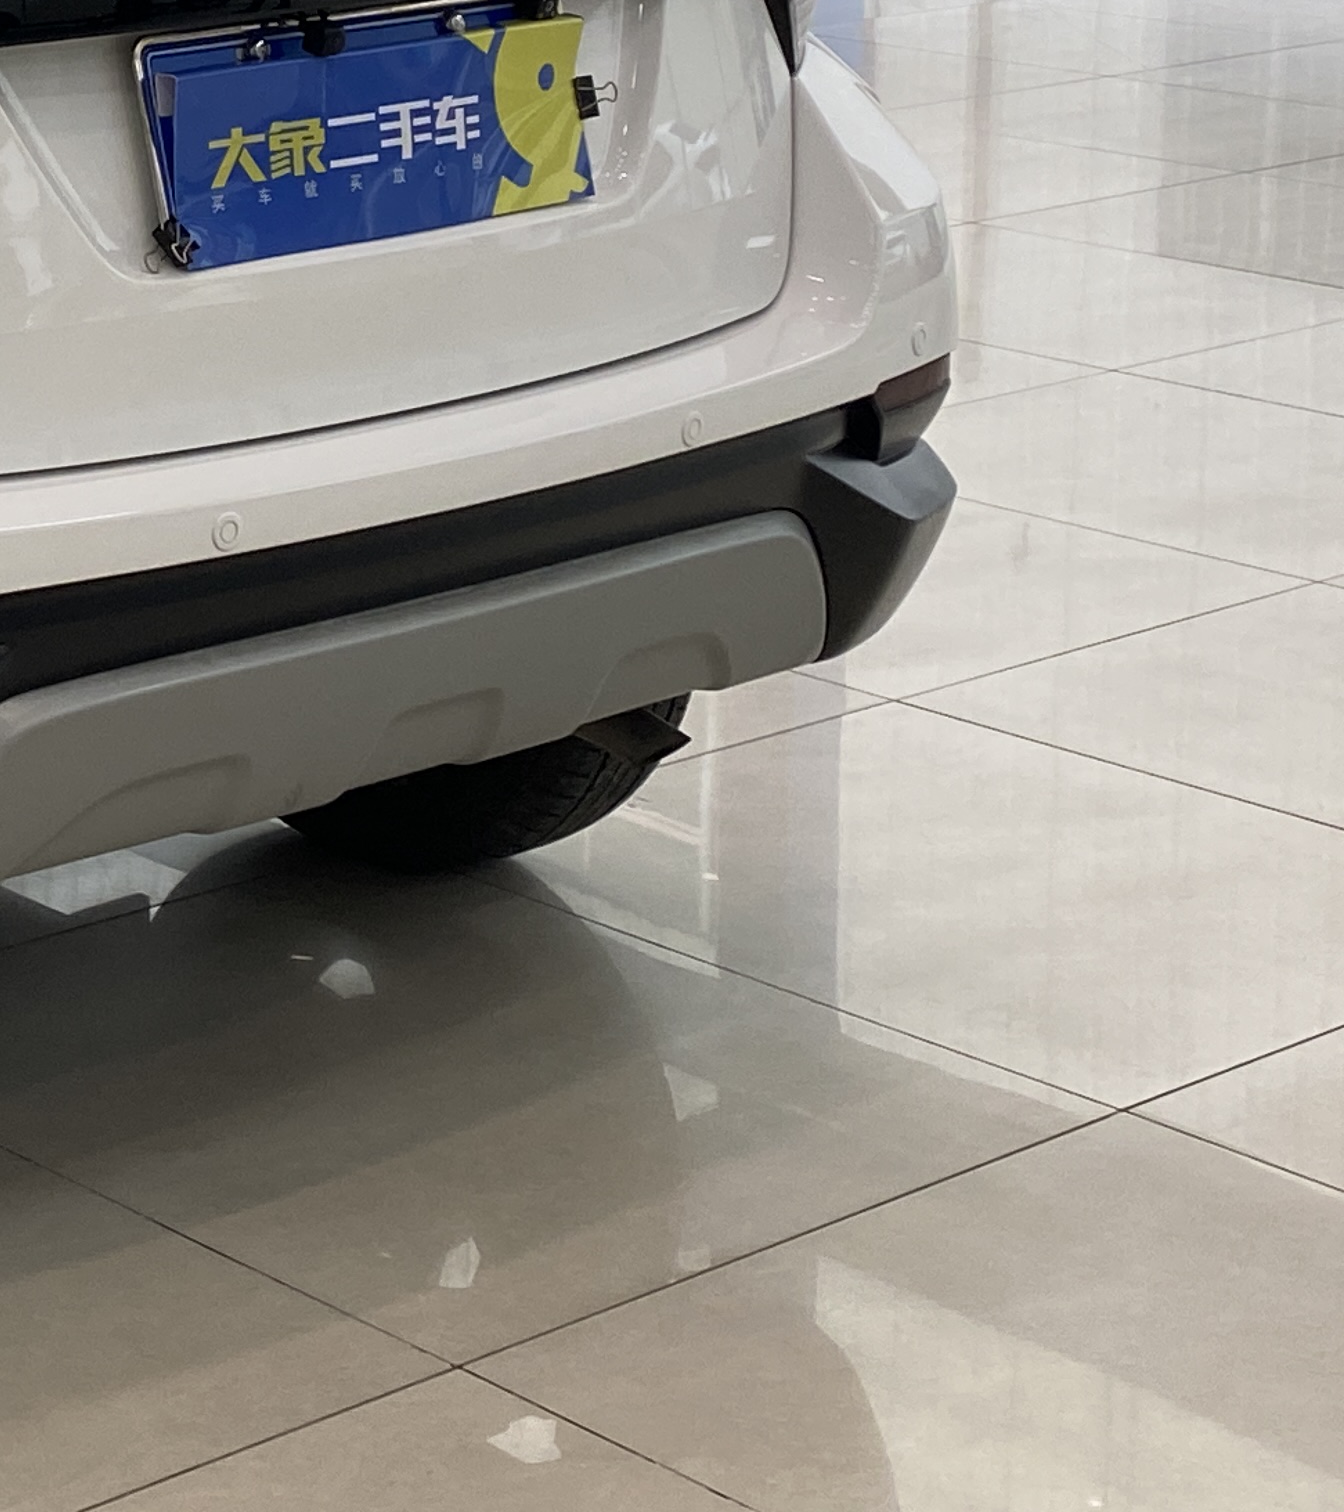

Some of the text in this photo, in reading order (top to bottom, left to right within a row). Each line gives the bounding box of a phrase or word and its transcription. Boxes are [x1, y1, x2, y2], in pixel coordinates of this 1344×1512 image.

[207, 94, 481, 190] 大象二手车
